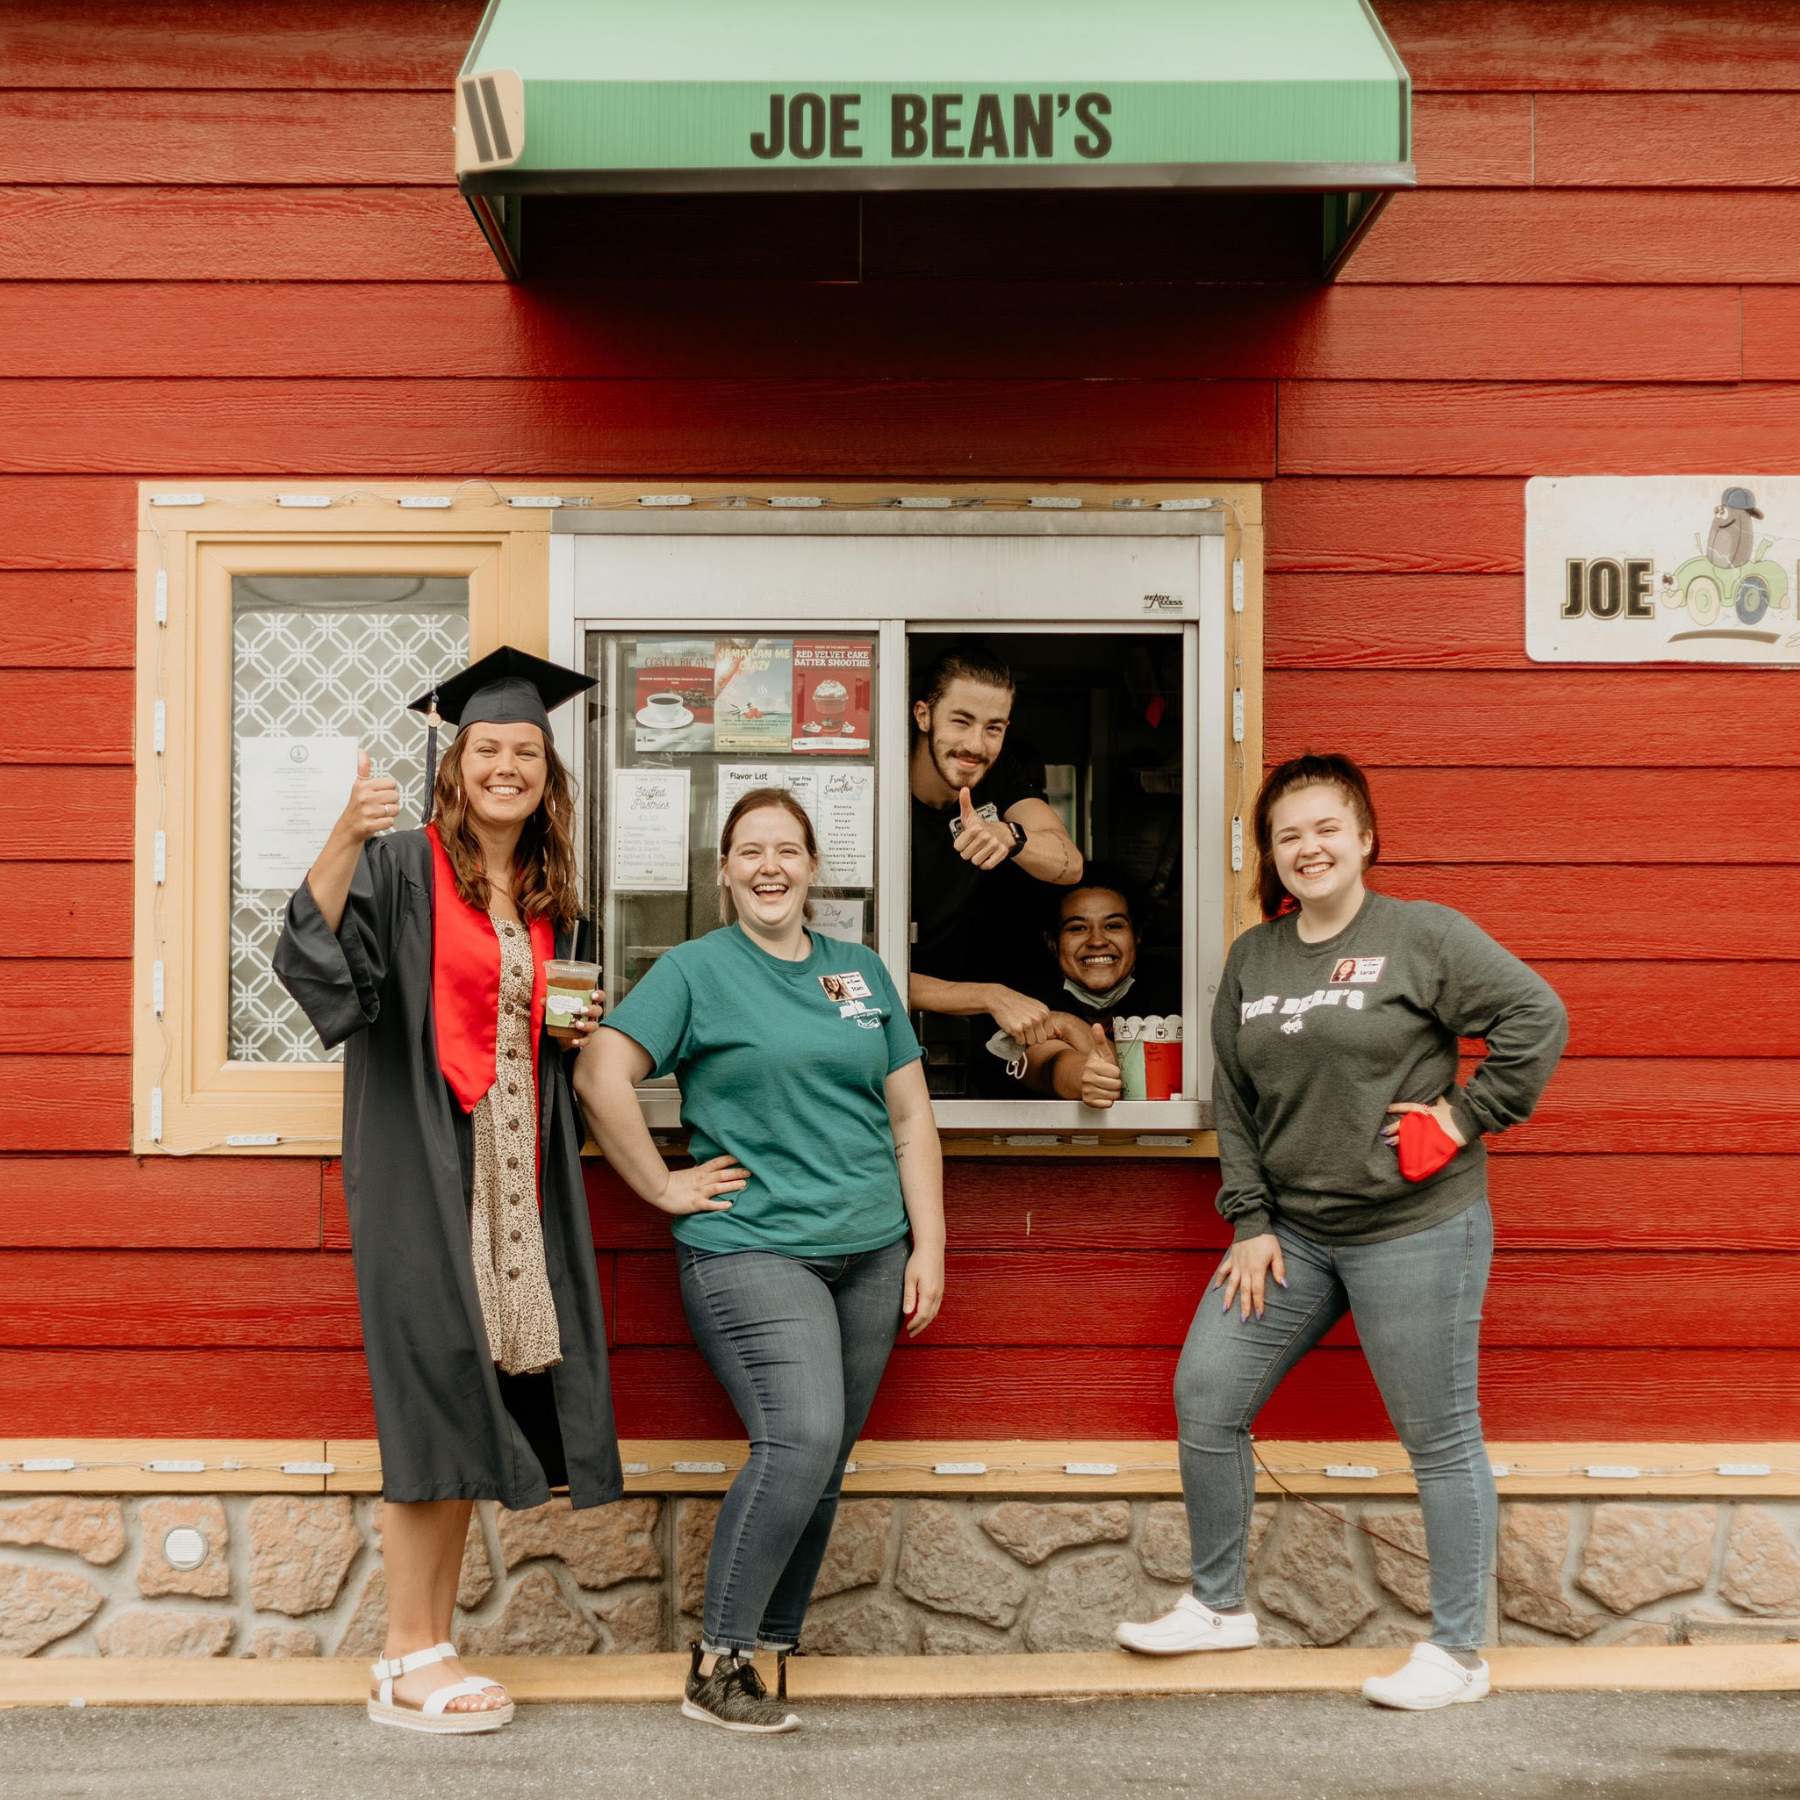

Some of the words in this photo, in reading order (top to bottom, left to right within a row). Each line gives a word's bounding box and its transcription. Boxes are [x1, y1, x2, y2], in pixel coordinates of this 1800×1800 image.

[750, 93, 863, 160] JOE
[891, 91, 1112, 160] BEAN'S
[1560, 557, 1655, 621] JOE
[1143, 593, 1170, 602] READY
[718, 648, 772, 660] JAMAICAN
[775, 648, 791, 659] ME
[796, 650, 813, 658] RED
[814, 650, 845, 659] VELVET
[847, 651, 869, 659] CAKE
[645, 656, 675, 669] COSTA
[680, 656, 708, 669] RICAN
[739, 660, 771, 671] CRAZY
[794, 658, 826, 667] BATTER
[828, 659, 871, 667] SMOOTHIE
[730, 772, 753, 780] Flavor
[755, 772, 768, 780] List
[829, 773, 847, 784] Fruit
[635, 785, 667, 800] Stuffed
[823, 780, 854, 795] Smoothie
[630, 798, 670, 810] Pastries
[822, 903, 842, 921] Day
